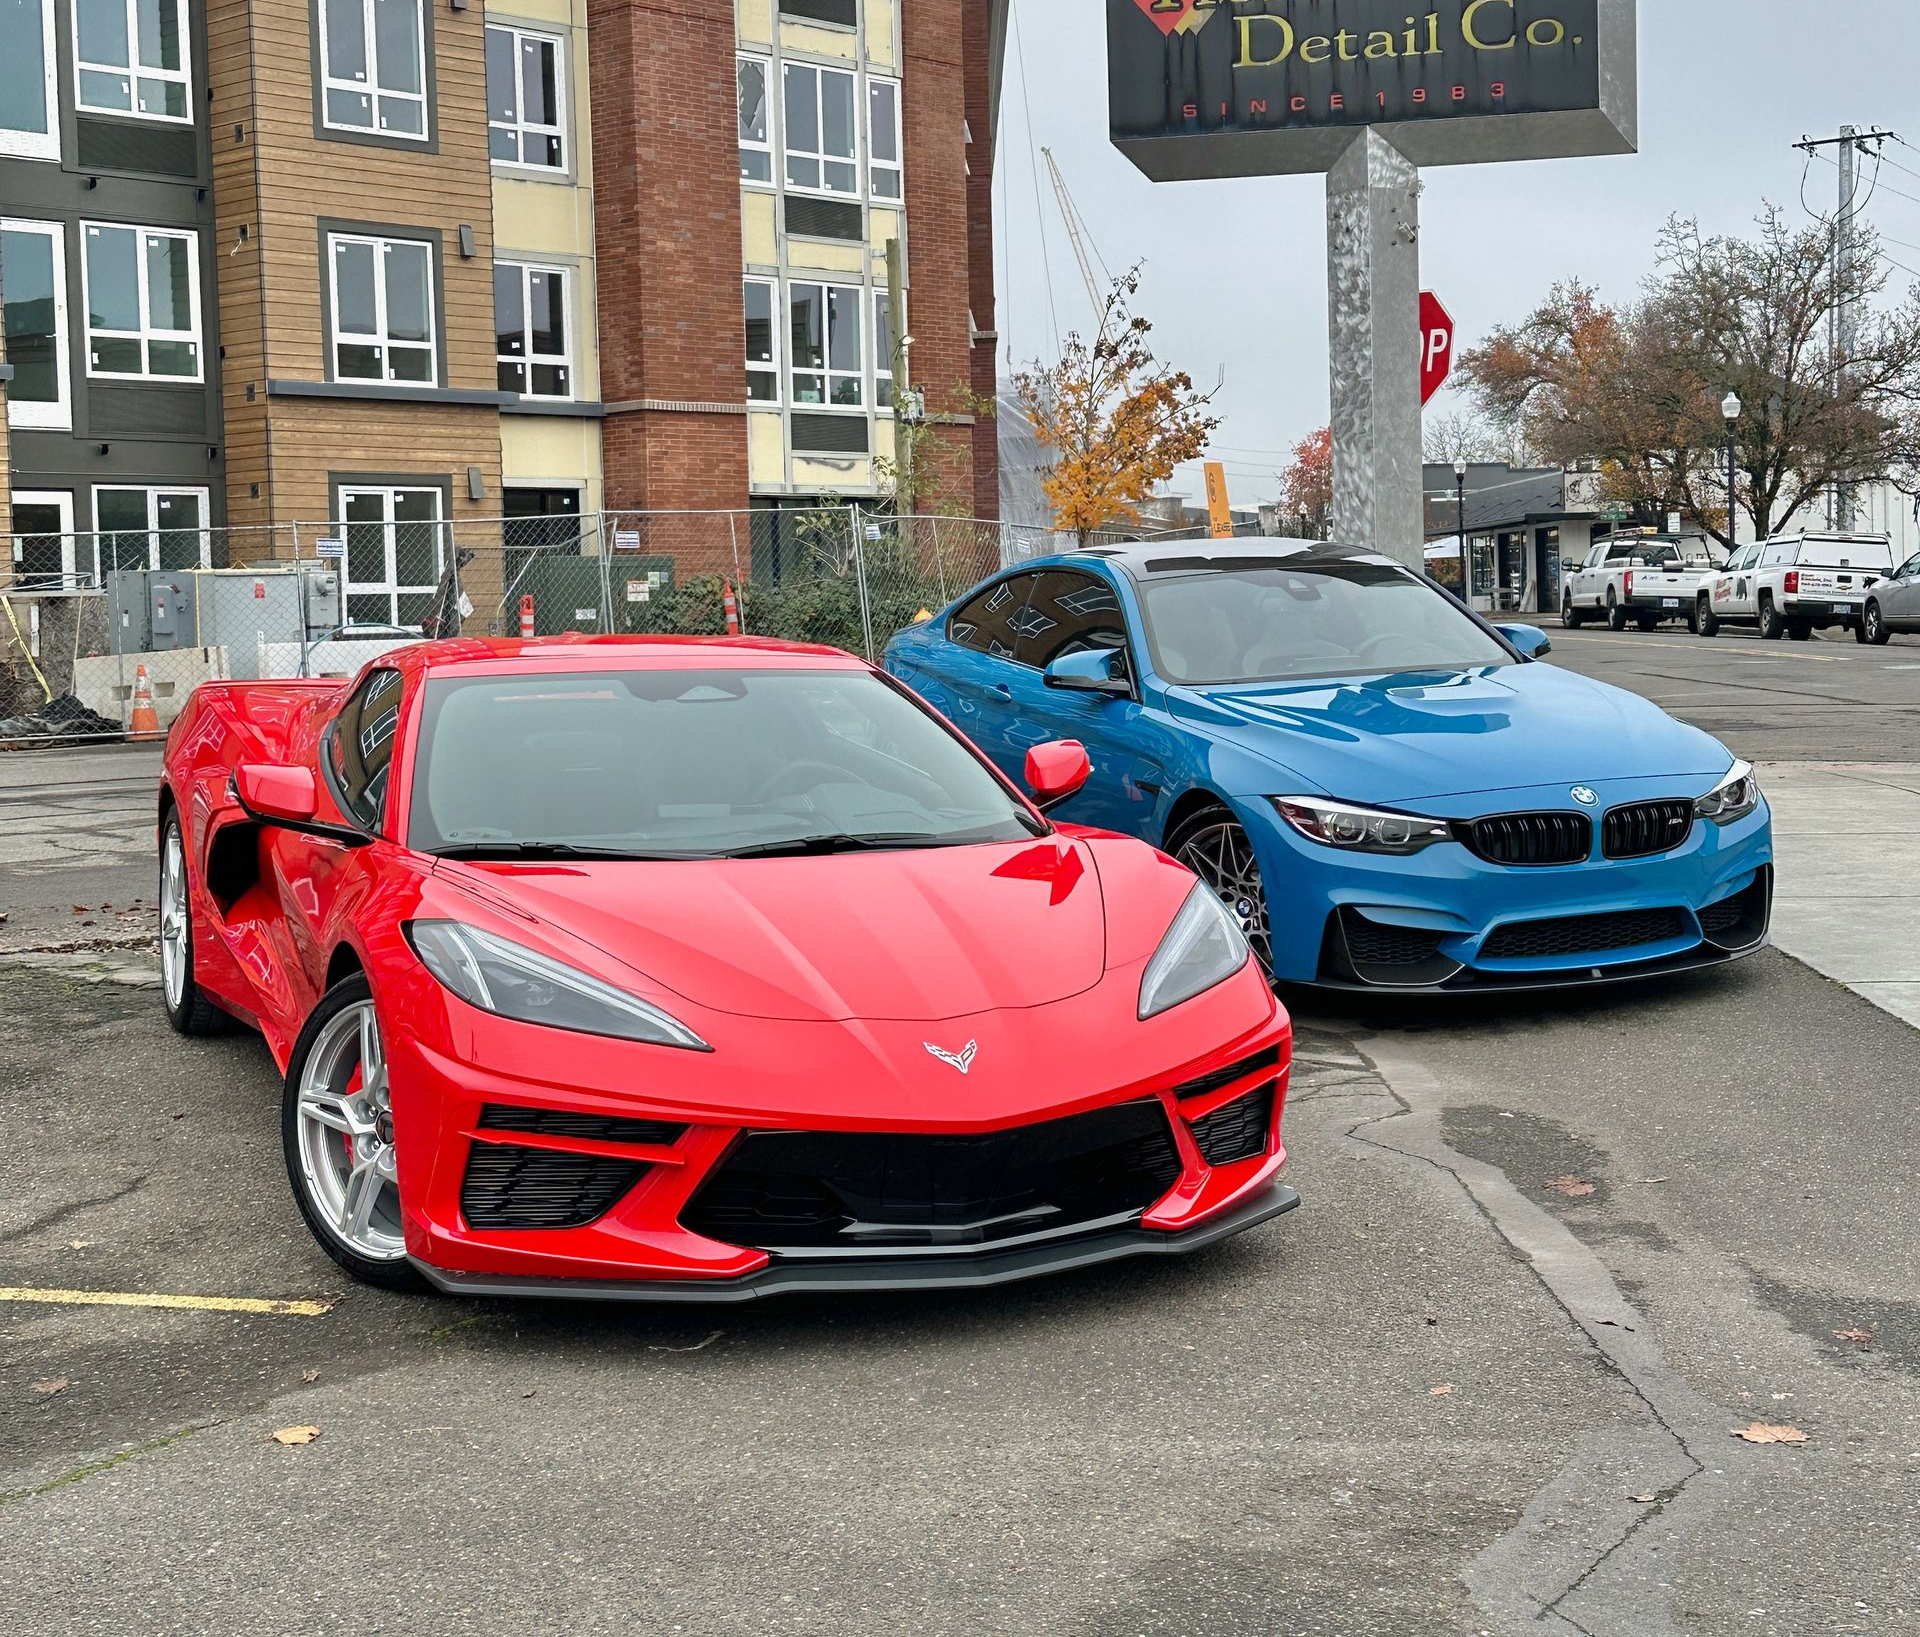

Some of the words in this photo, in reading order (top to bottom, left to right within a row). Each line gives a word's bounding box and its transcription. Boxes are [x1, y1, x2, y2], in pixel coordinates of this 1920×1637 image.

[1232, 12, 1443, 68] Detail
[1461, 0, 1583, 50] Co.
[1182, 93, 1344, 119] SINCE
[1375, 82, 1506, 107] 1983
